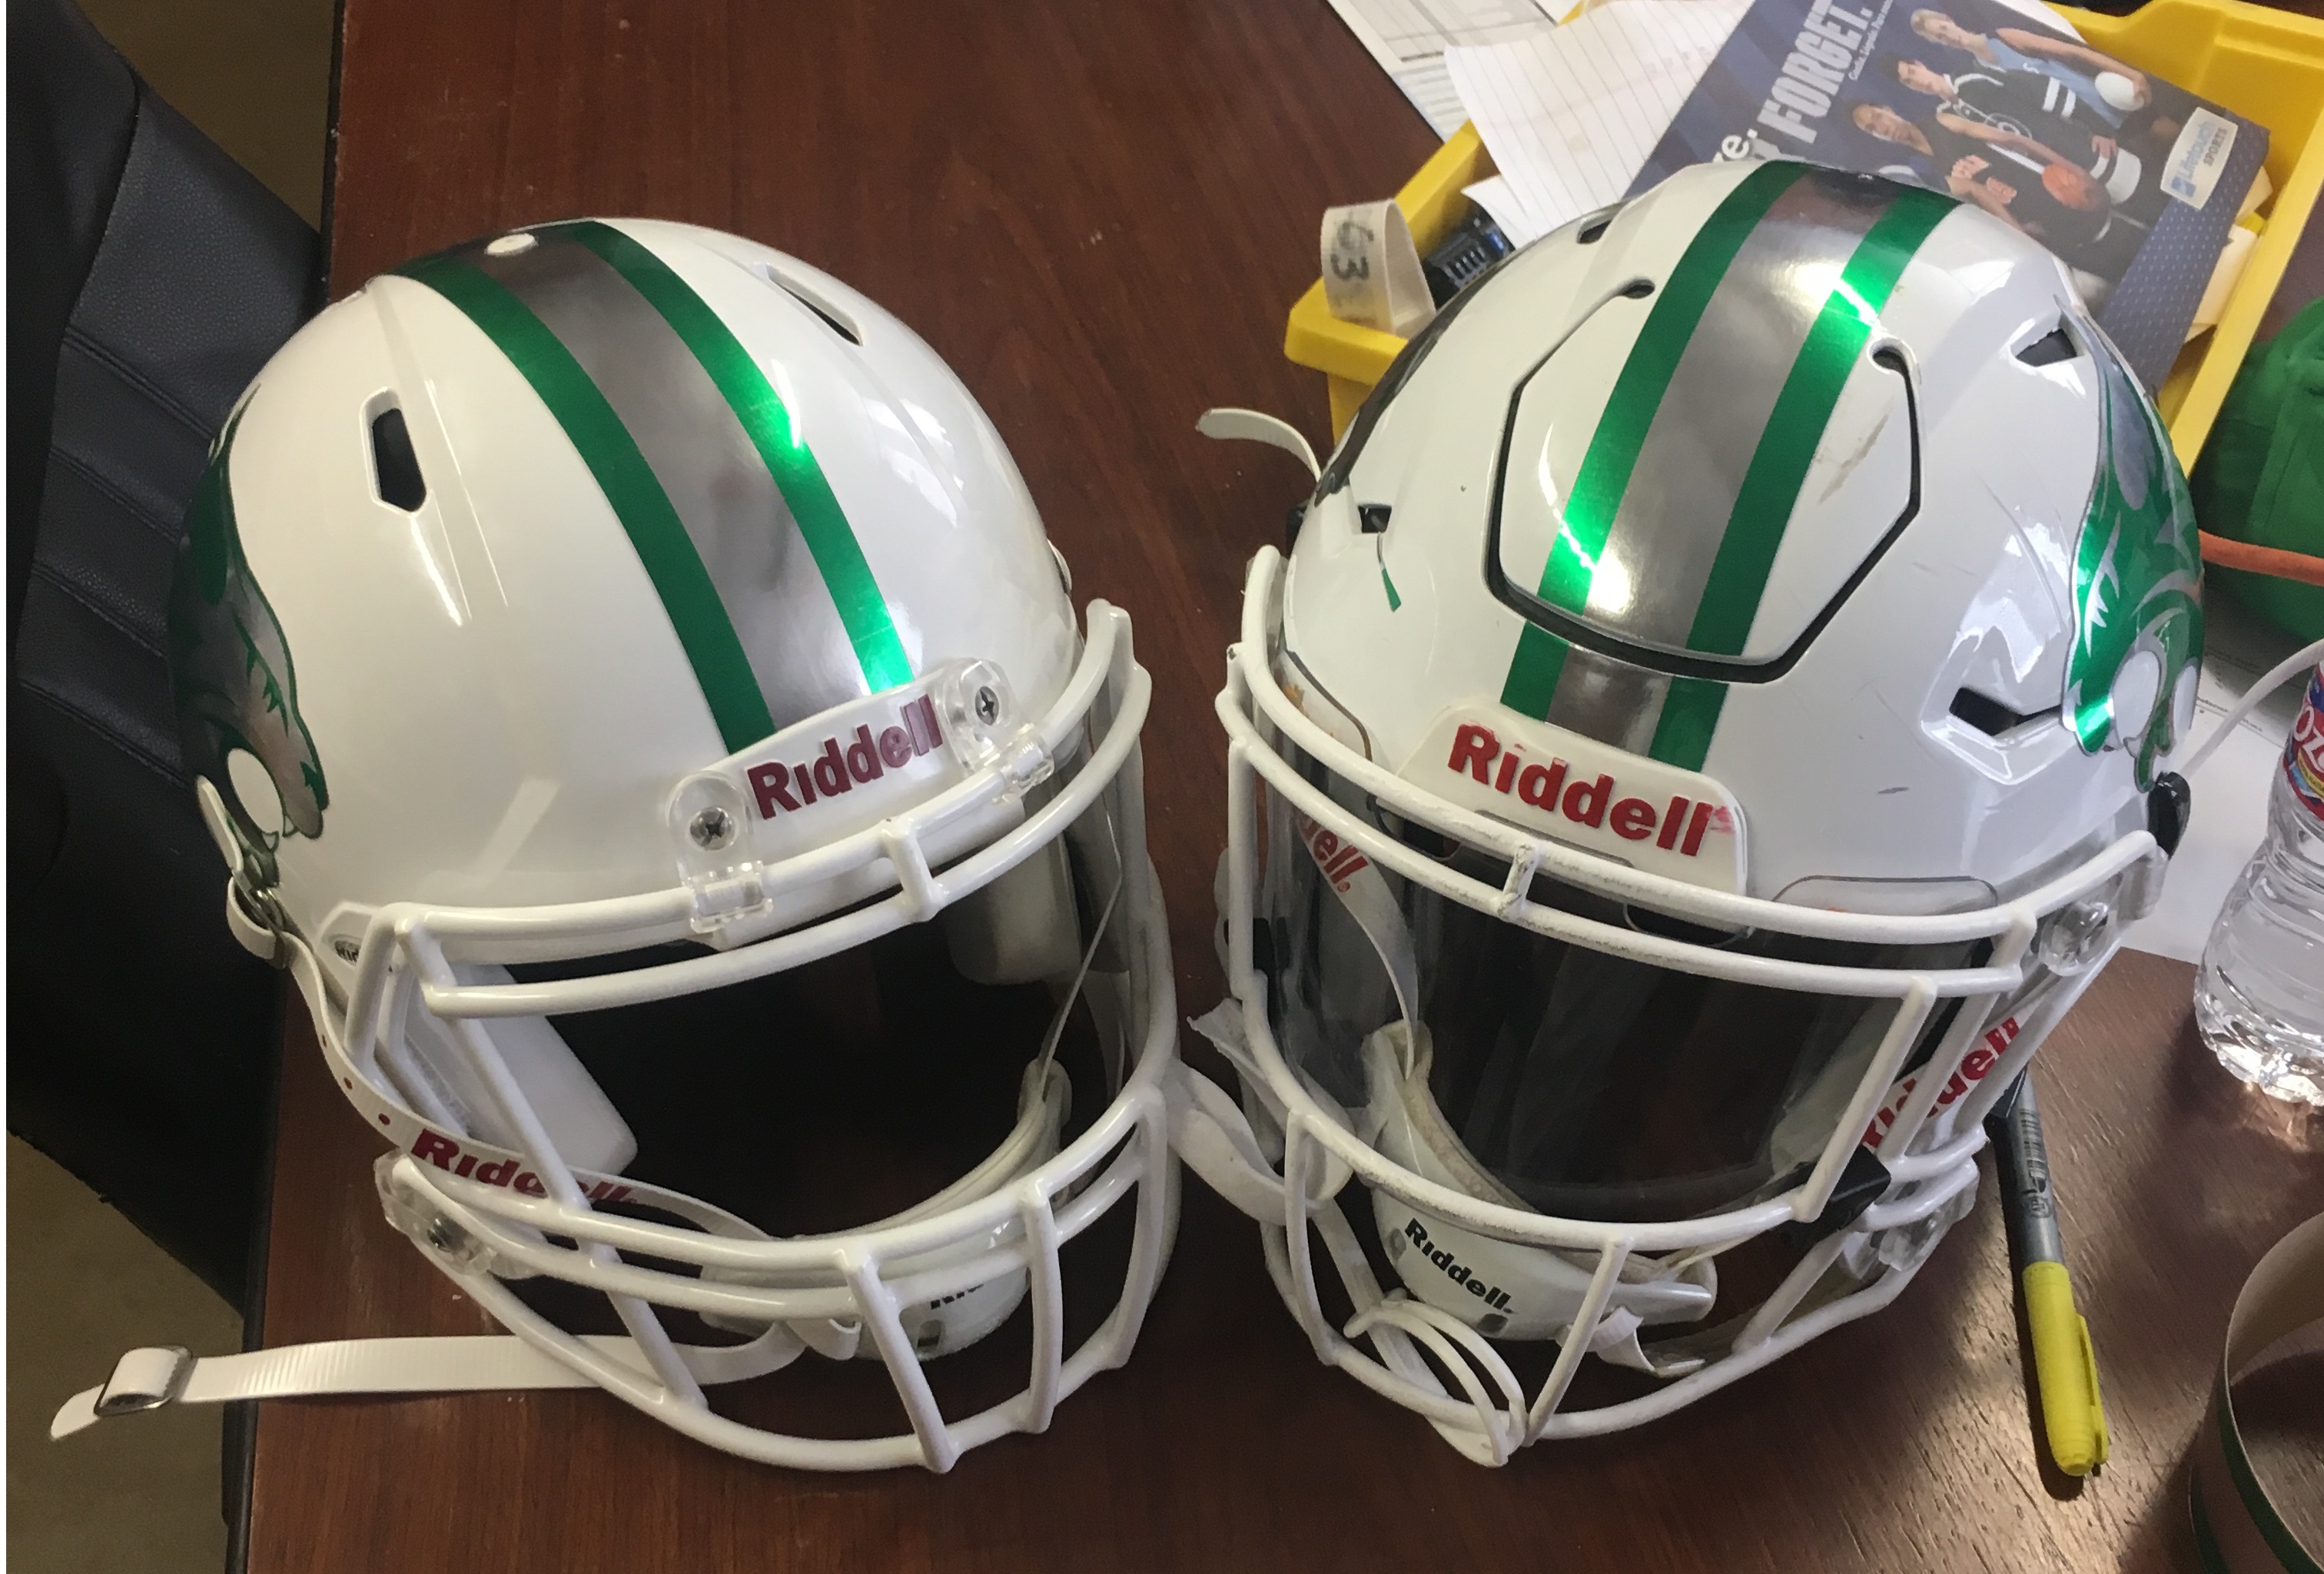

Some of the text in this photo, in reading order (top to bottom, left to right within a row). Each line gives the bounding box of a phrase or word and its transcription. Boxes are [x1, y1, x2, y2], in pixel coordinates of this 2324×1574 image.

[1757, 0, 1873, 144] FORGET.
[2176, 121, 2213, 180] Lifetouch
[2203, 127, 2228, 167] SPORTS
[746, 694, 944, 820] Riddell
[1447, 723, 1715, 857] Riddell
